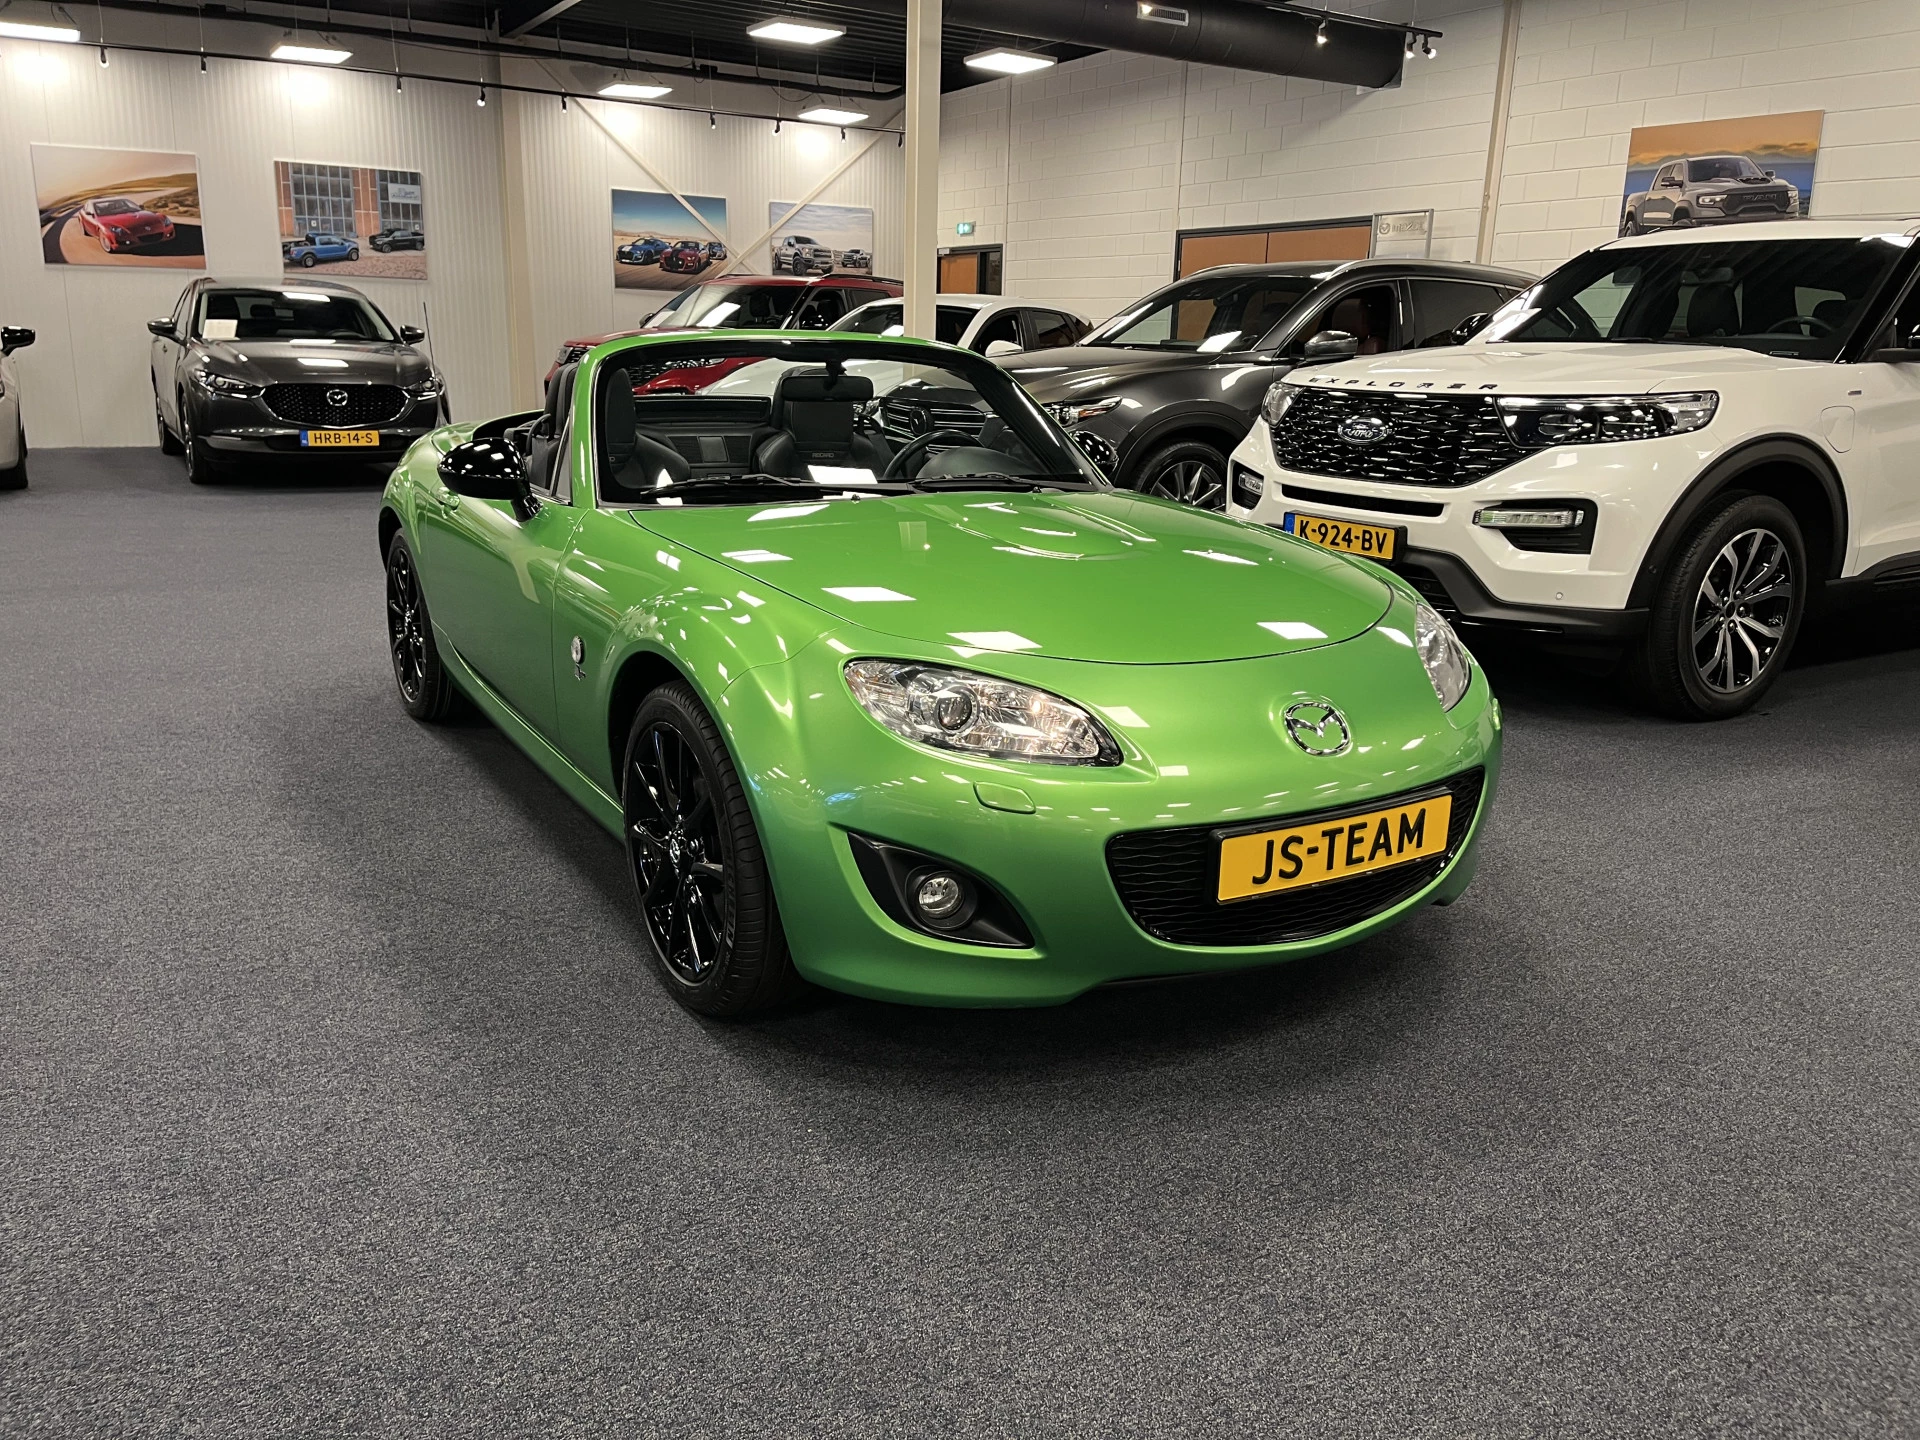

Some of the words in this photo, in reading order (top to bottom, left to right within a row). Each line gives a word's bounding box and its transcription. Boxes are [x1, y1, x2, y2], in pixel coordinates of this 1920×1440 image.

[1308, 377, 1498, 390] EXPLORER
[313, 433, 373, 444] HRB-14-S
[1300, 519, 1387, 553] K-924-BV
[1252, 808, 1426, 885] JS-TEAM
